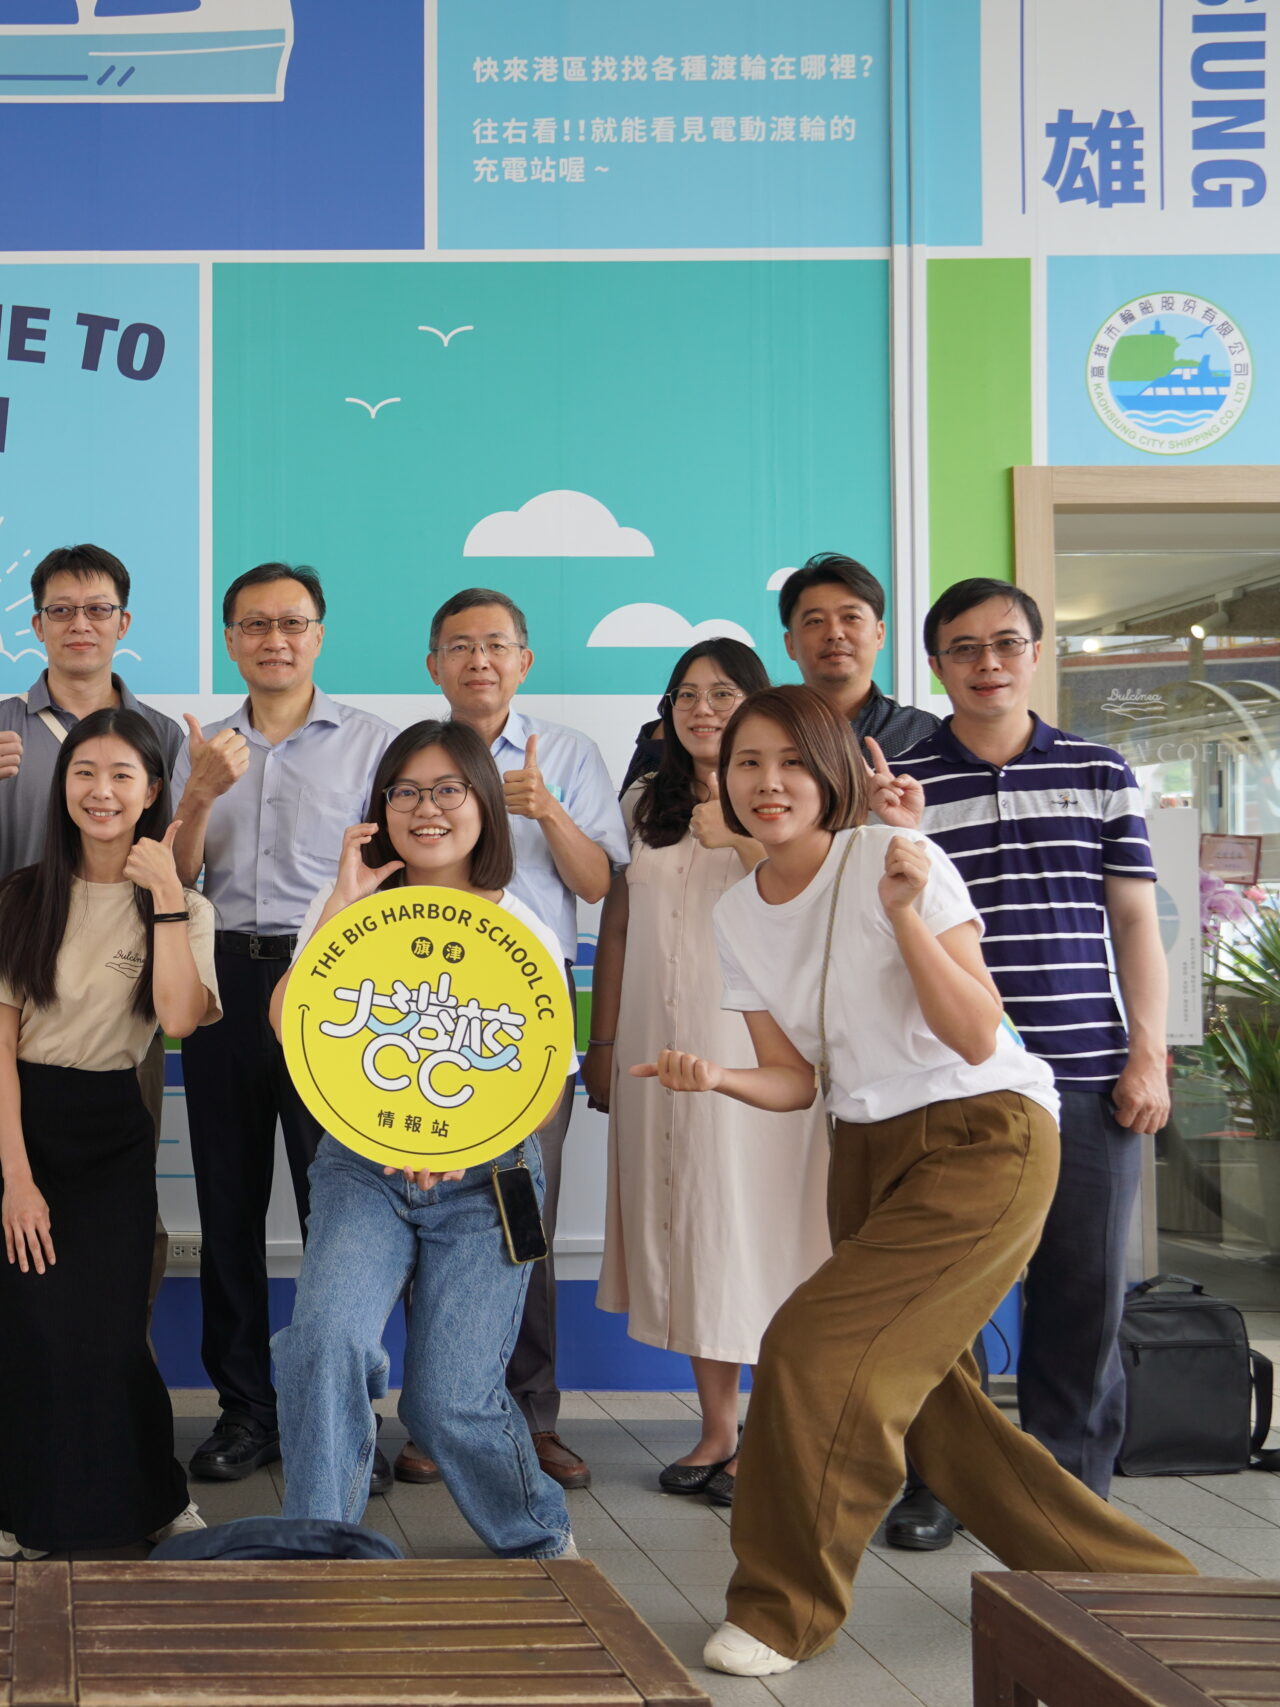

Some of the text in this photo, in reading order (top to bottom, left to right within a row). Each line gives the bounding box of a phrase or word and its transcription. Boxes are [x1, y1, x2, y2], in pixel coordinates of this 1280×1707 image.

[472, 54, 874, 83] 快來港區找找各種渡輪在哪裡?
[1190, 0, 1267, 208] IUNG
[472, 115, 857, 144] 往右看!!就能看見電動渡輪的
[1041, 108, 1146, 208] 雄
[75, 311, 166, 382] TO
[1090, 295, 1249, 378] 高雄市輪船股份有限公司
[1093, 382, 1137, 440] KAOHSIUNG
[1138, 435, 1166, 449] CITY
[1168, 424, 1221, 449] SHIPPING
[310, 903, 555, 1021] THE BIG HARBOR SCHOOL CC
[412, 937, 464, 963] 旗津
[361, 1032, 475, 1109] CC
[377, 1109, 450, 1138] 情報站
